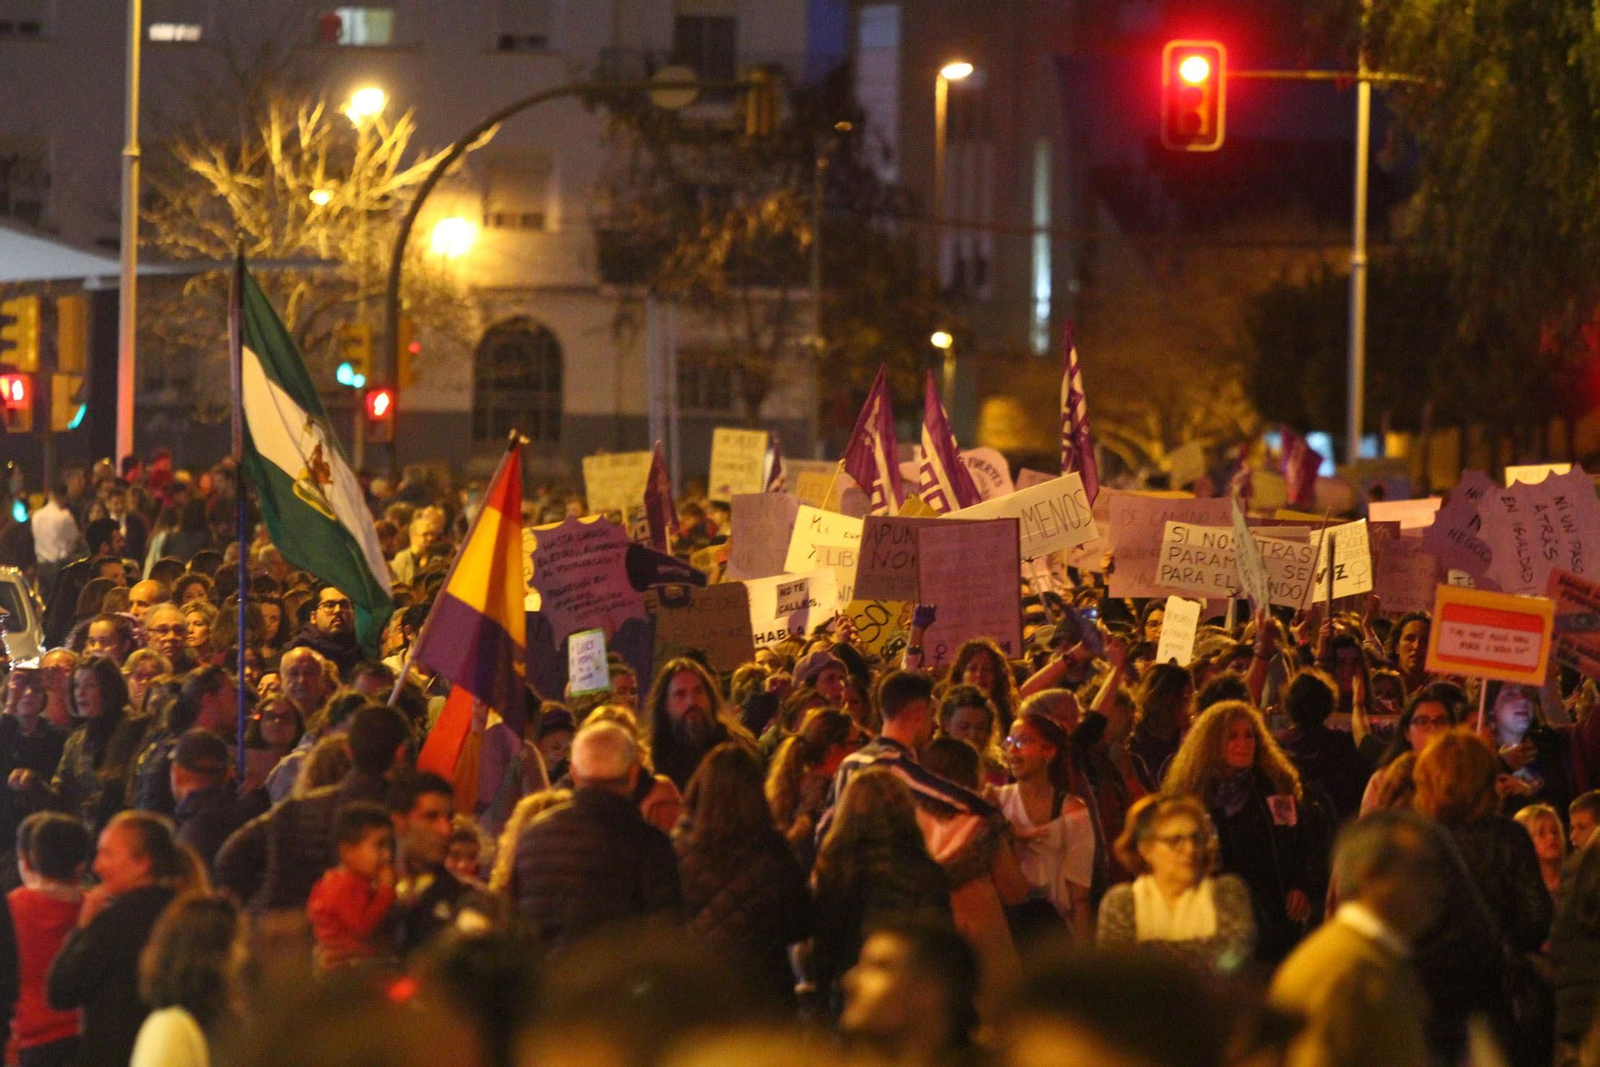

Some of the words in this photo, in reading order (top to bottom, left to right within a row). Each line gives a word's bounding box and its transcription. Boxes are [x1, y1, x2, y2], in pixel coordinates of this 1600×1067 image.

[1020, 488, 1093, 543] MENOS
[1500, 495, 1519, 513] EN
[1533, 503, 1558, 561] ATRÁS
[1560, 514, 1578, 533] UN
[1171, 526, 1190, 544] SI
[1202, 531, 1313, 564] NOTRAS
[1568, 540, 1584, 573] PASO
[1161, 564, 1205, 584] PARA
[1213, 573, 1236, 589] EL
[1267, 577, 1303, 600] NDO
[1283, 564, 1310, 581] SE
[1315, 563, 1350, 585] VZ
[779, 585, 792, 597] NO
[793, 582, 805, 592] TE
